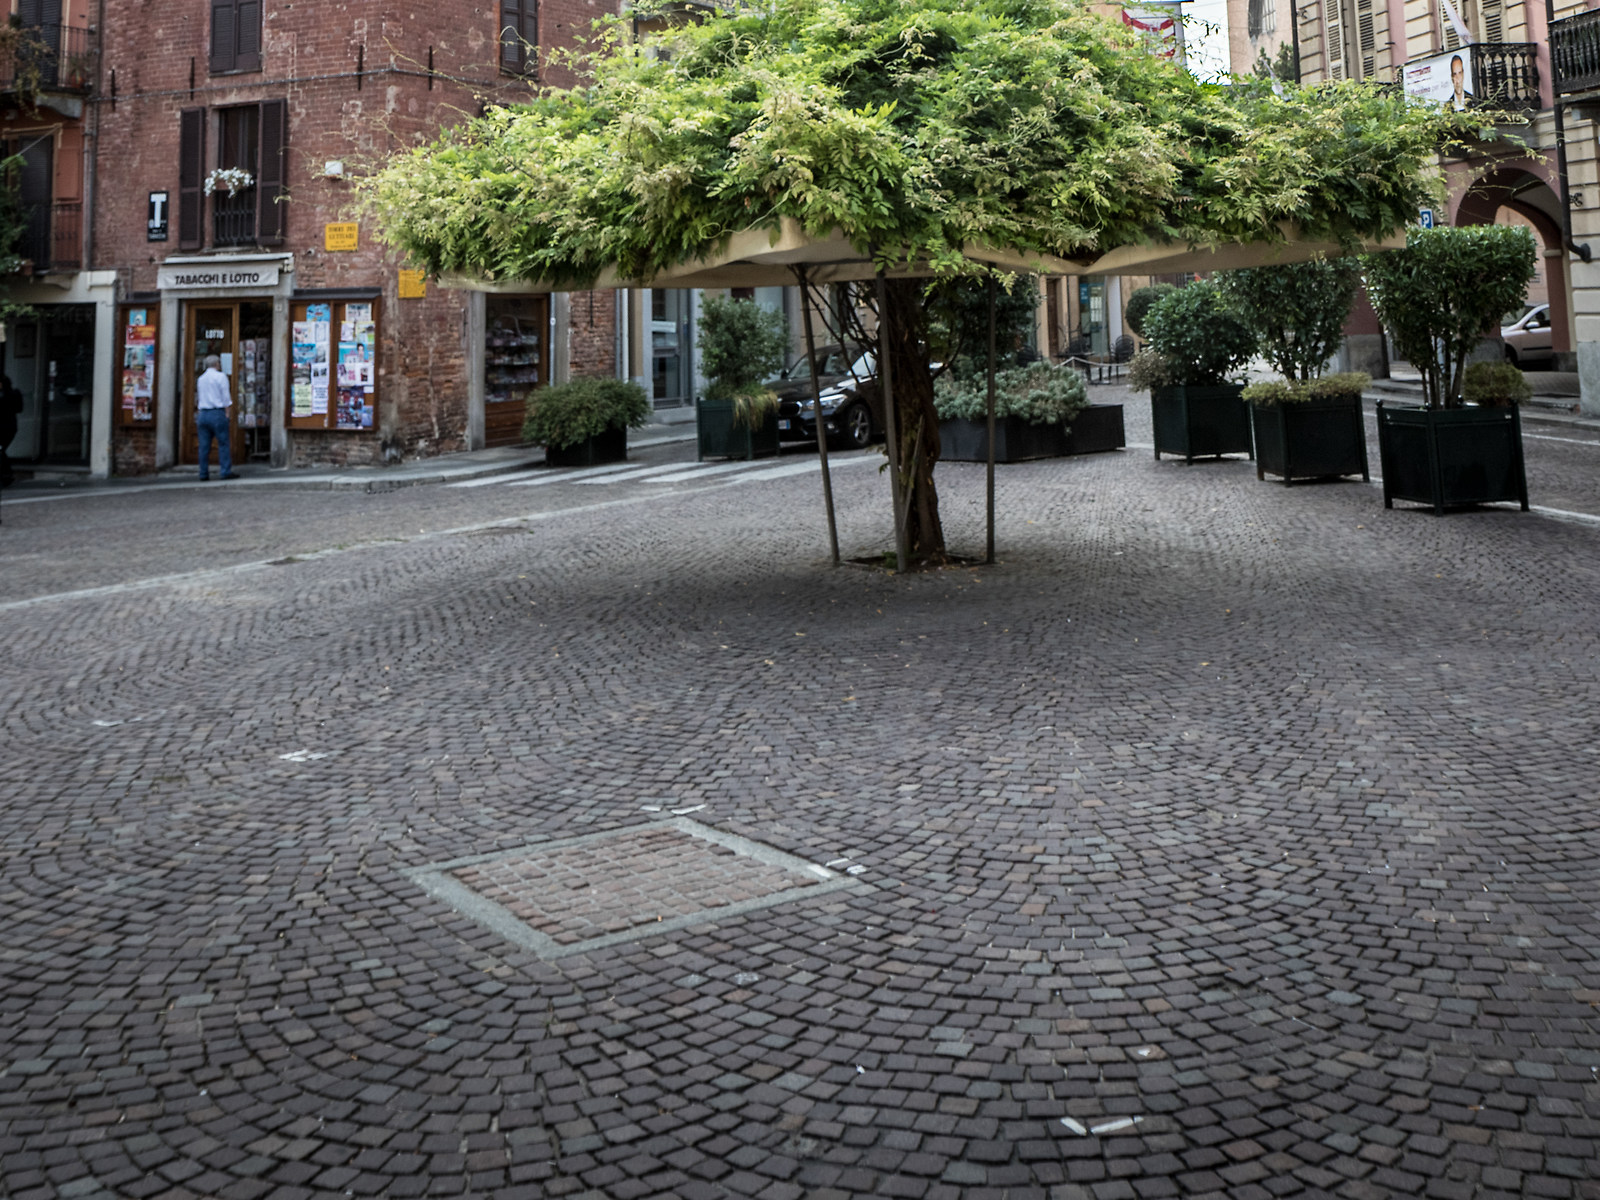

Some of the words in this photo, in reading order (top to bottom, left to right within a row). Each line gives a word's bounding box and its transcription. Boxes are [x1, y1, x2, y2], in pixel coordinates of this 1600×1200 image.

[151, 193, 167, 228] T
[1422, 213, 1430, 228] P
[175, 274, 219, 285] TABACCHI
[222, 274, 227, 283] E
[230, 273, 260, 283] LOTTO
[205, 330, 224, 339] LOTTO
